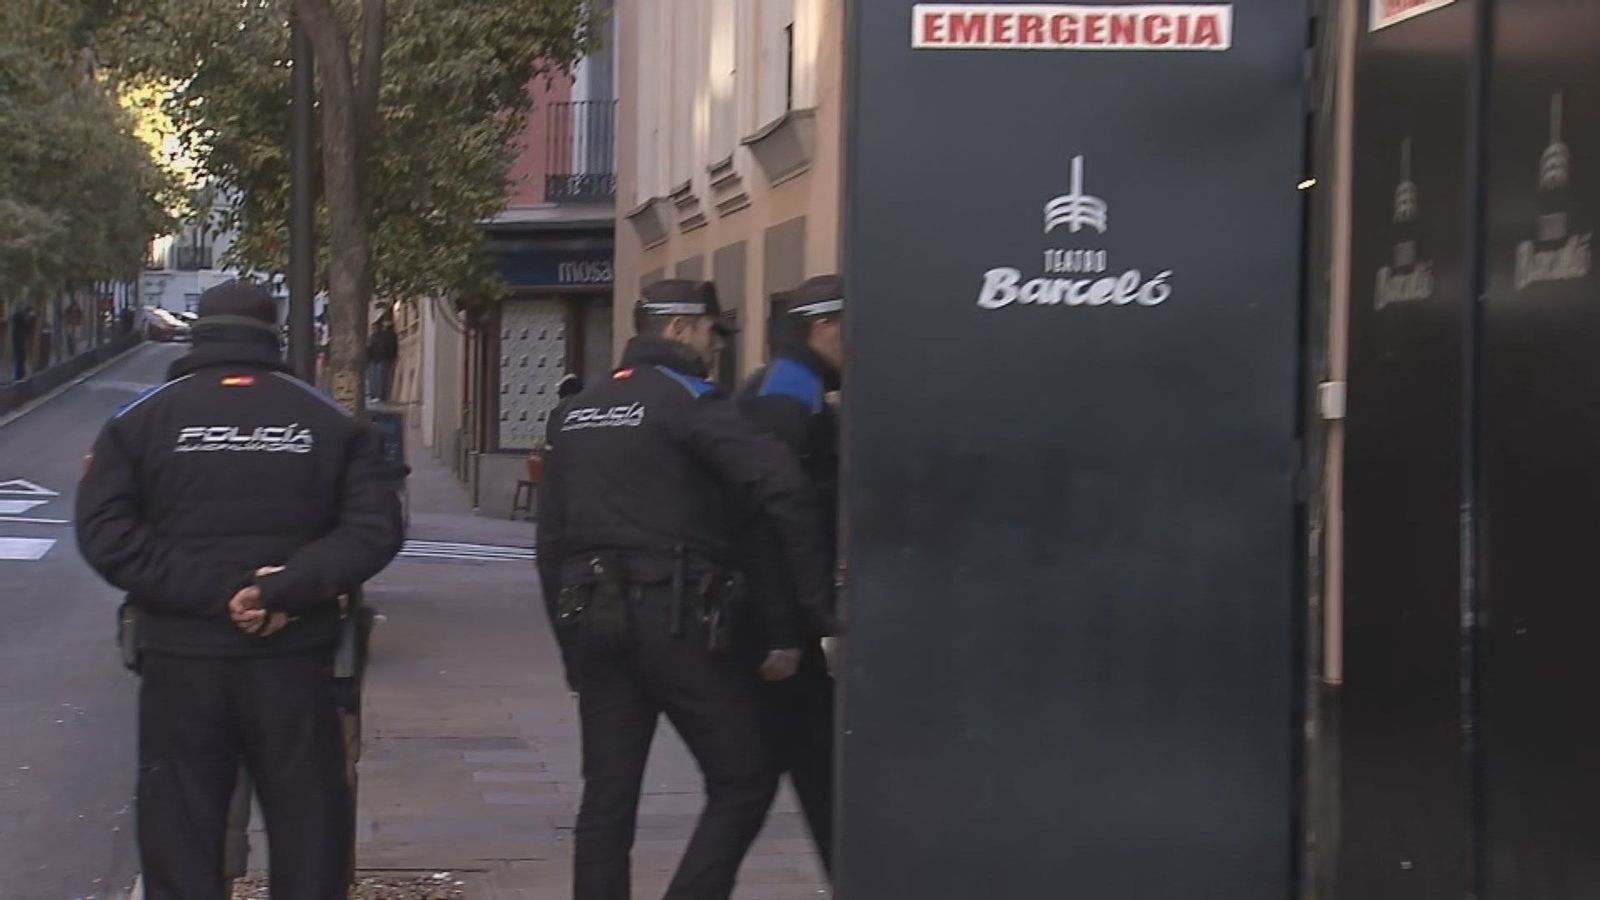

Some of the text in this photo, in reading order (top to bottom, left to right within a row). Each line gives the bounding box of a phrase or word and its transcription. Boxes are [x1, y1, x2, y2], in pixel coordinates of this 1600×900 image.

[922, 11, 1226, 47] EMERGENCIA
[1043, 249, 1107, 273] TEATRO
[977, 267, 1172, 309] Barceló
[176, 423, 314, 444] POLICÍA
